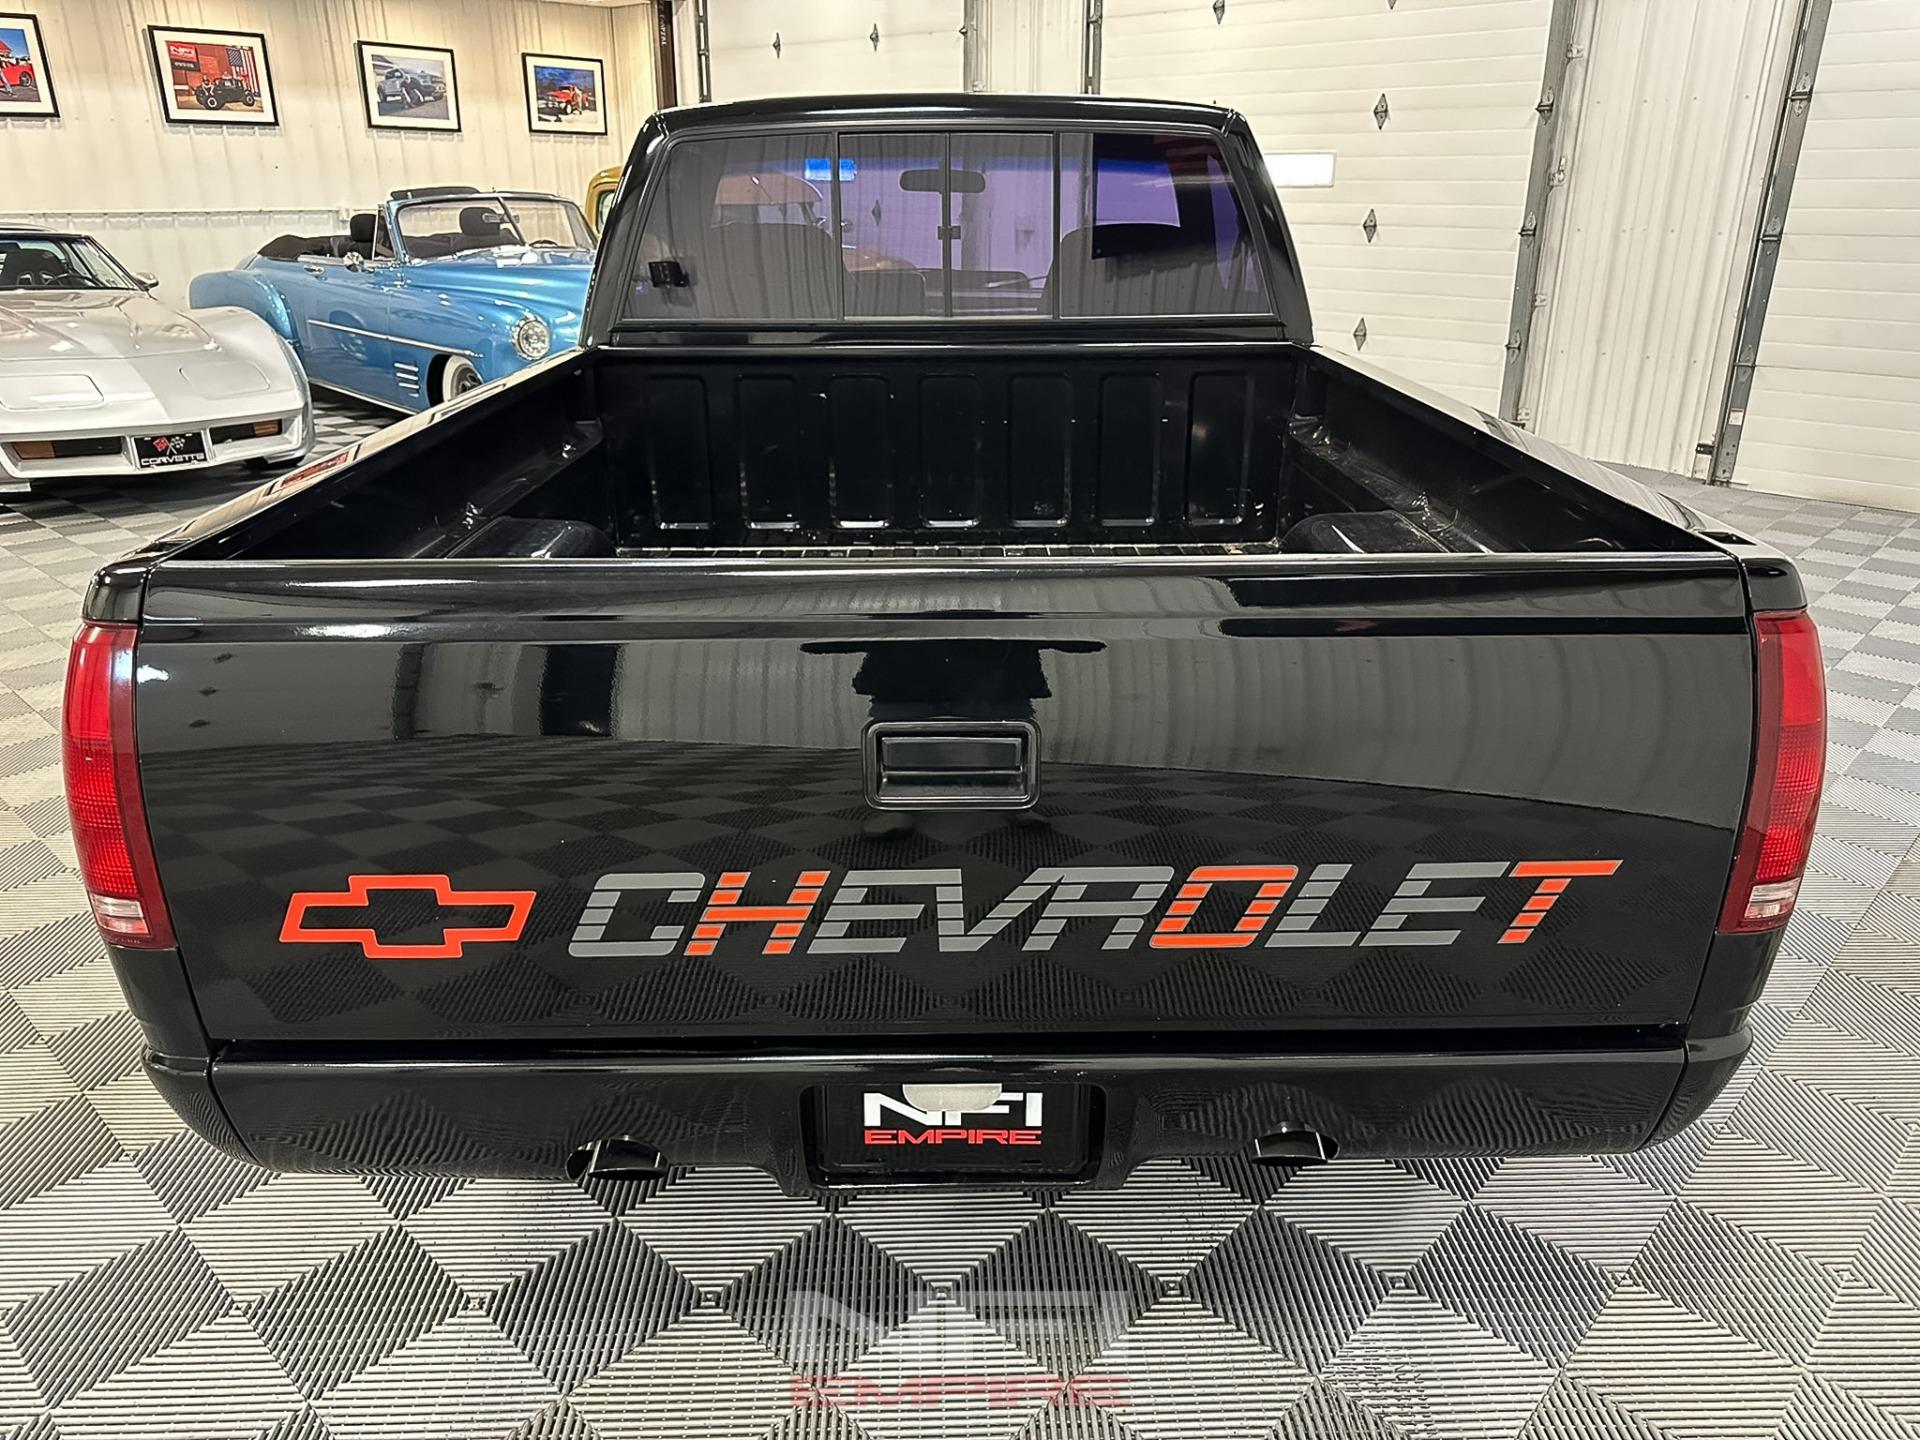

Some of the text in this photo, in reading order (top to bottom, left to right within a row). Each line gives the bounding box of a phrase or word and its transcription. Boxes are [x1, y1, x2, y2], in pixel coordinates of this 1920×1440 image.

[141, 453, 205, 466] CORVETTE
[568, 859, 1624, 957] CHEVROLET
[864, 1129, 1042, 1145] EMPIRE
